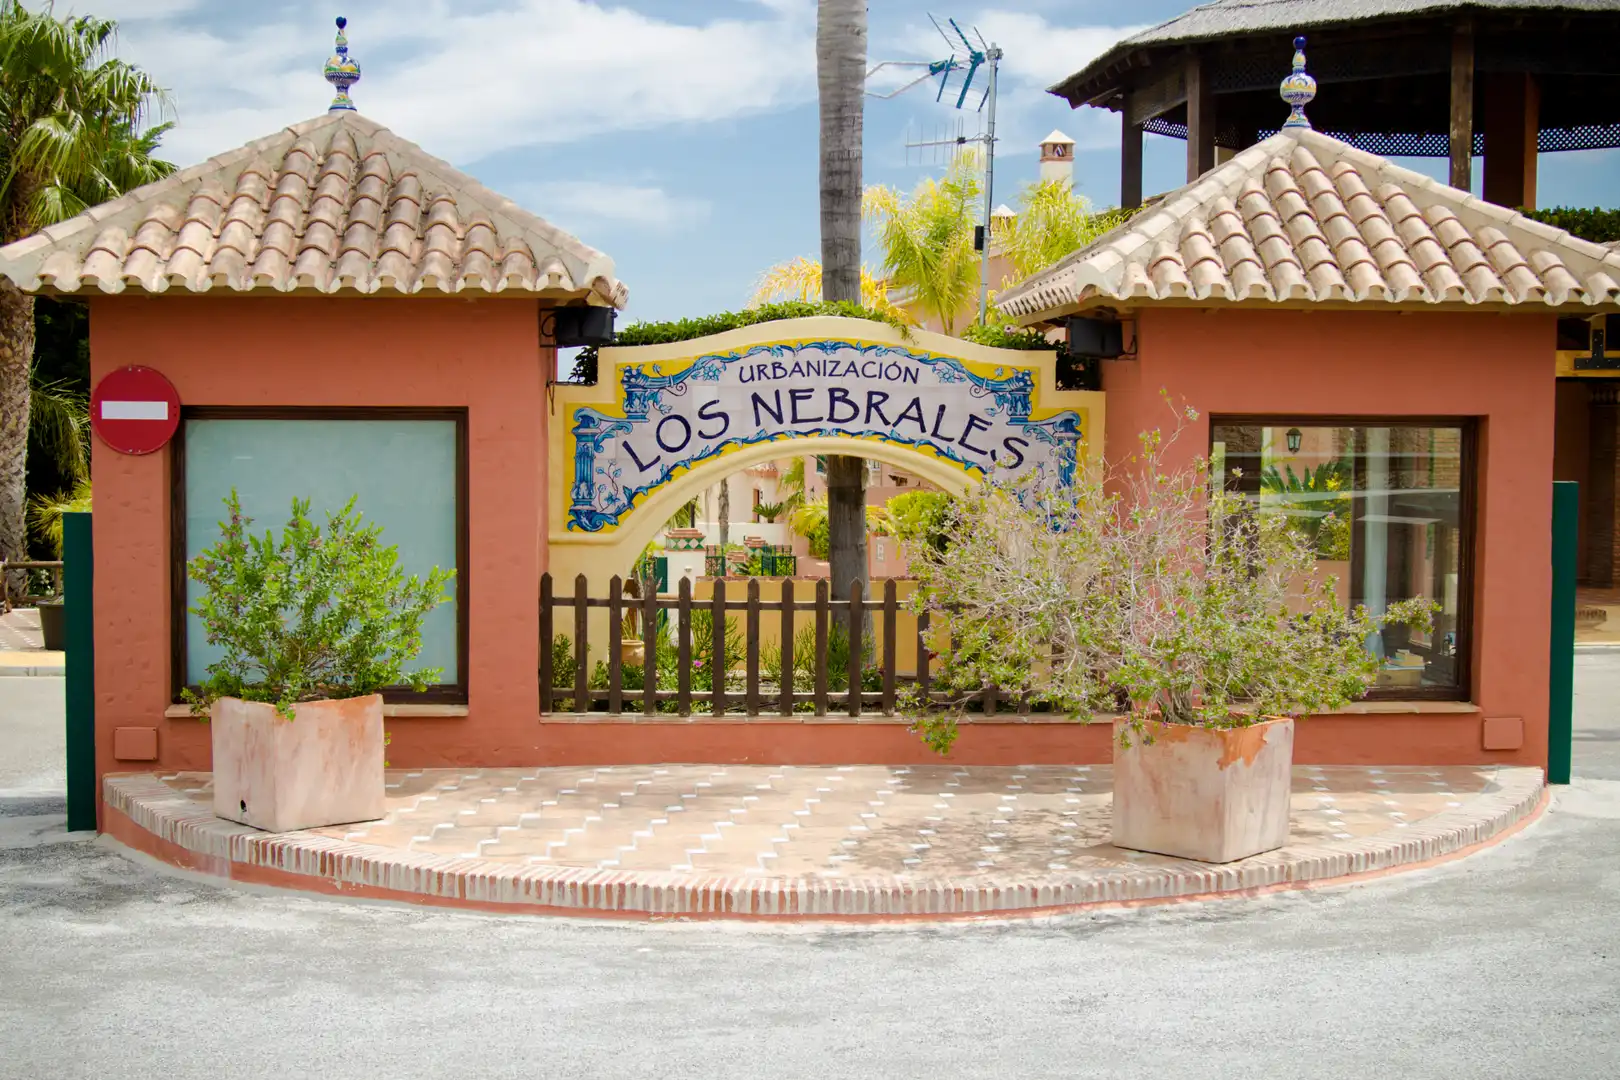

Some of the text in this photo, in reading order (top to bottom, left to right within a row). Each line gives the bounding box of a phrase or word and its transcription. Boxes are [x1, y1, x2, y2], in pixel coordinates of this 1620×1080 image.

[738, 359, 920, 385] URBANIZACIÓN
[621, 386, 1031, 473] LOS NEBRALES
